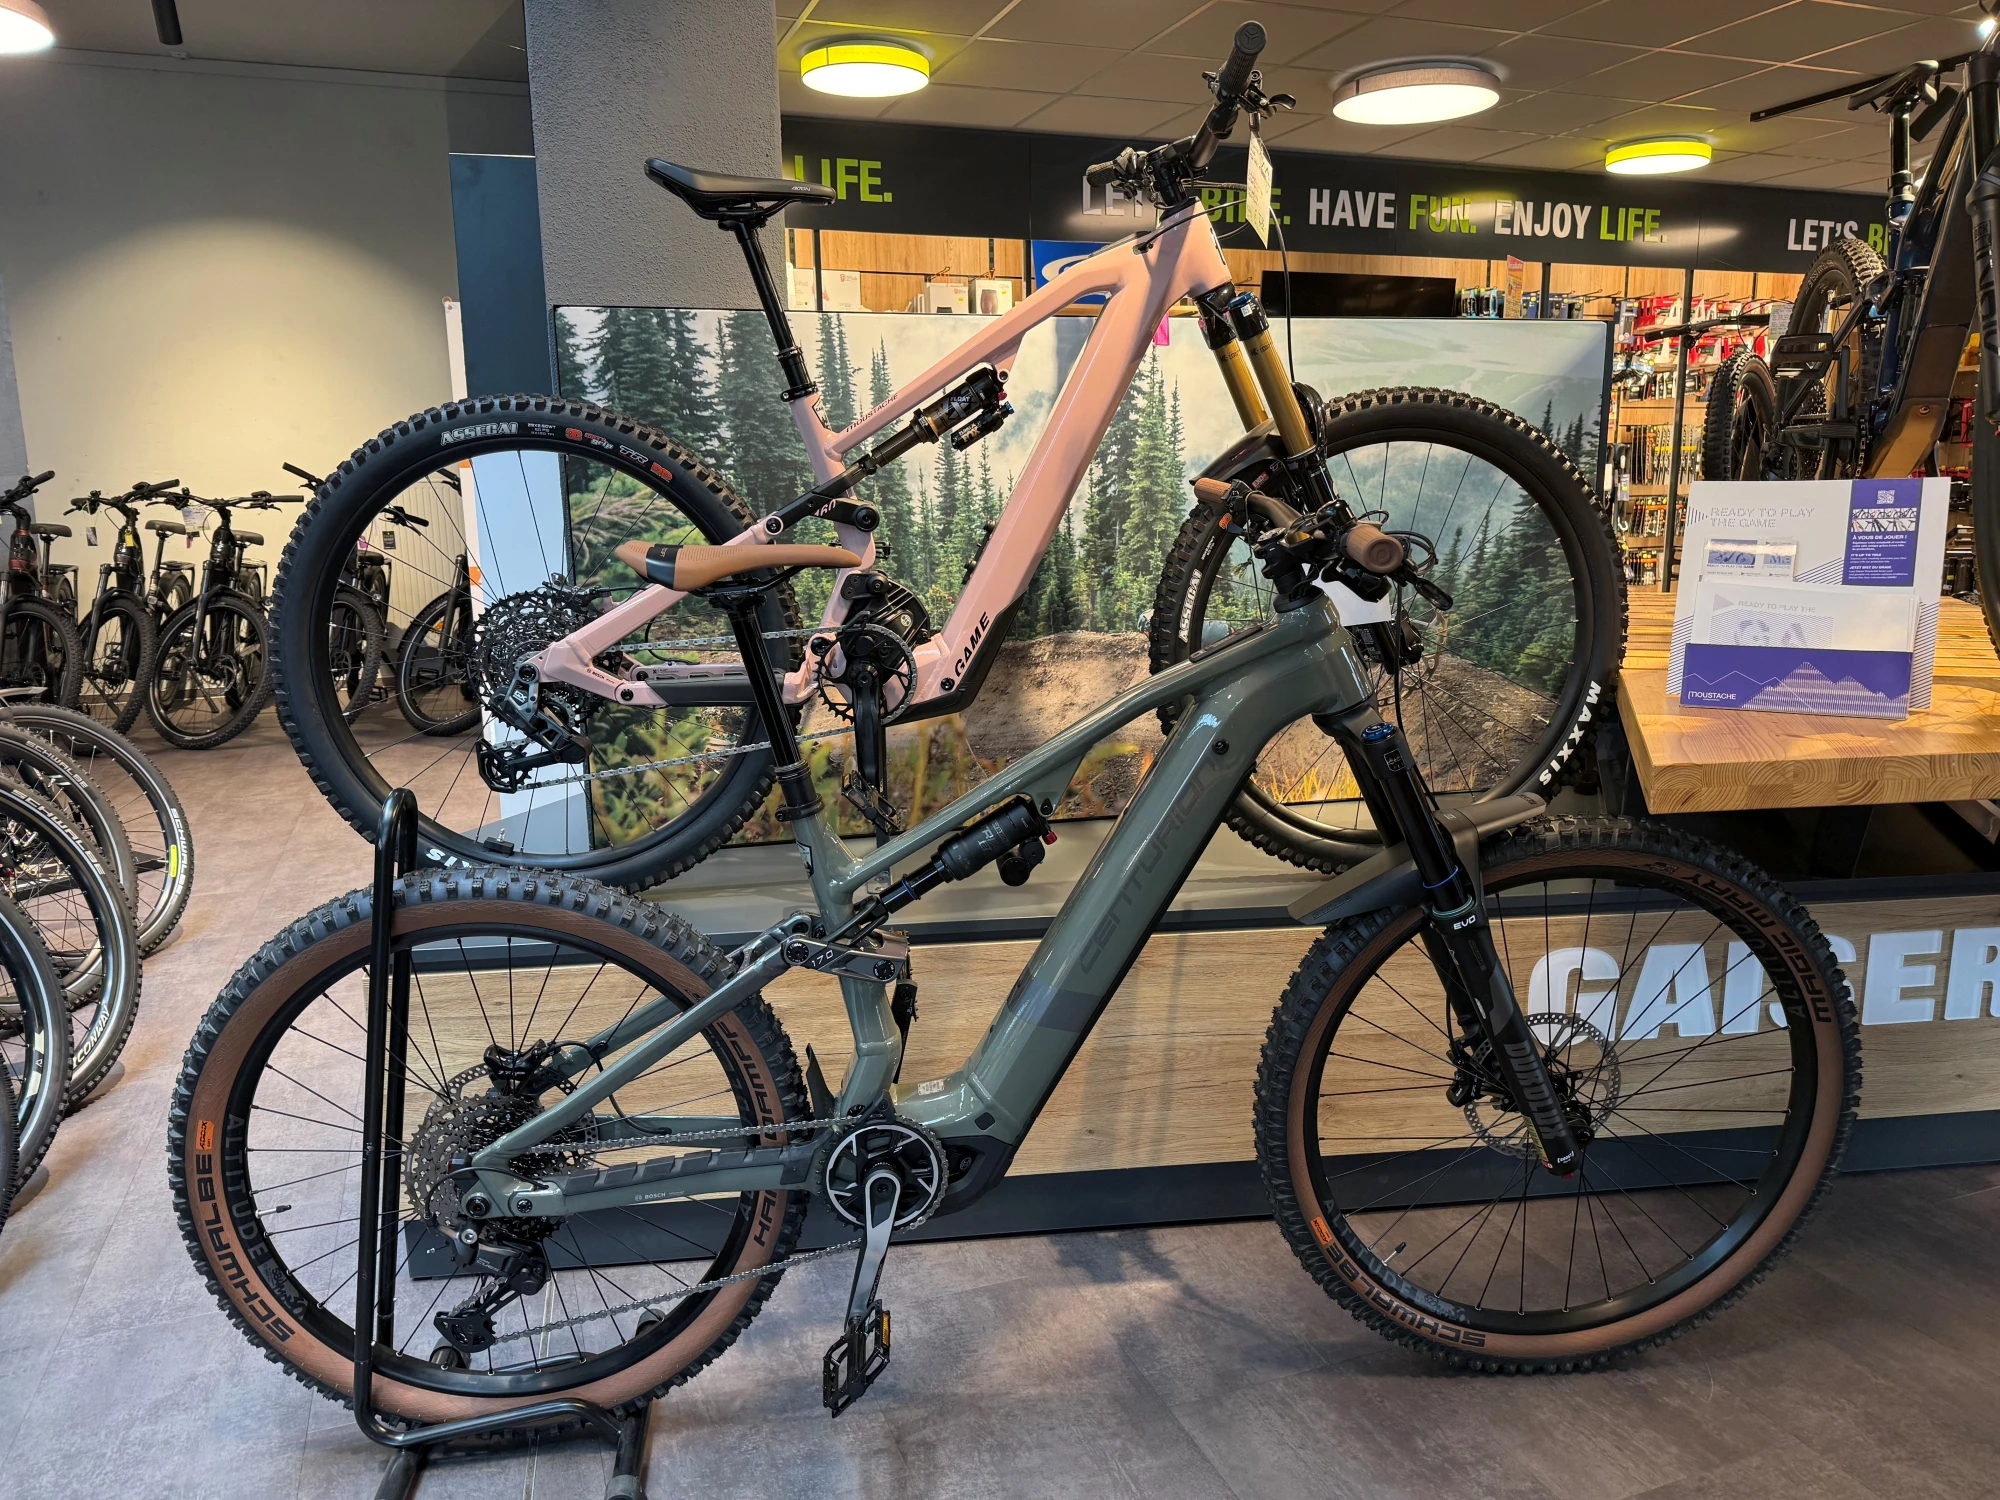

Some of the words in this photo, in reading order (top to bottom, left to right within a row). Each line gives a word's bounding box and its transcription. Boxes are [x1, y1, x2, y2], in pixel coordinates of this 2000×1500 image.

[1082, 176, 1143, 218] LET
[1202, 188, 1290, 225] BIE.
[1309, 188, 1395, 229] HAVE
[1409, 194, 1477, 234] FUN.
[1494, 199, 1591, 239] ENJOY
[1600, 205, 1668, 243] LIFE.
[440, 422, 518, 447] ASSEGAI
[845, 393, 899, 433] MOUSTACHE
[1710, 507, 1755, 517] READY
[1759, 508, 1777, 517] TO
[1781, 508, 1814, 517] PLAY
[1710, 518, 1736, 527] THE
[1740, 518, 1776, 528] GAME
[1738, 600, 1765, 609] READY
[1779, 604, 1799, 612] PLAY
[954, 612, 990, 677] GAME
[592, 671, 604, 679] BOSCH
[1688, 690, 1736, 700] MOUSTACHE
[1540, 681, 1601, 785] MAXXIS
[25, 740, 88, 789] SCHWALBE
[11, 789, 105, 875] SCHWALBE
[170, 807, 187, 896] SCHWALBE
[1080, 755, 1217, 975] CENTURION
[1453, 915, 1476, 930] EVO
[1682, 873, 1776, 929] MARY
[811, 950, 833, 967] 170
[1771, 931, 1832, 1023] MAGIC
[1528, 927, 2000, 1047] GAIER
[200, 1121, 208, 1149] ADDIX
[224, 1114, 272, 1262] ALTITUDE
[645, 1192, 665, 1200] BOSCH
[196, 1154, 296, 1343] SCHWALBE
[1323, 1200, 1418, 1299] ALTITUDE
[1326, 1241, 1486, 1348] SCHWALBE
